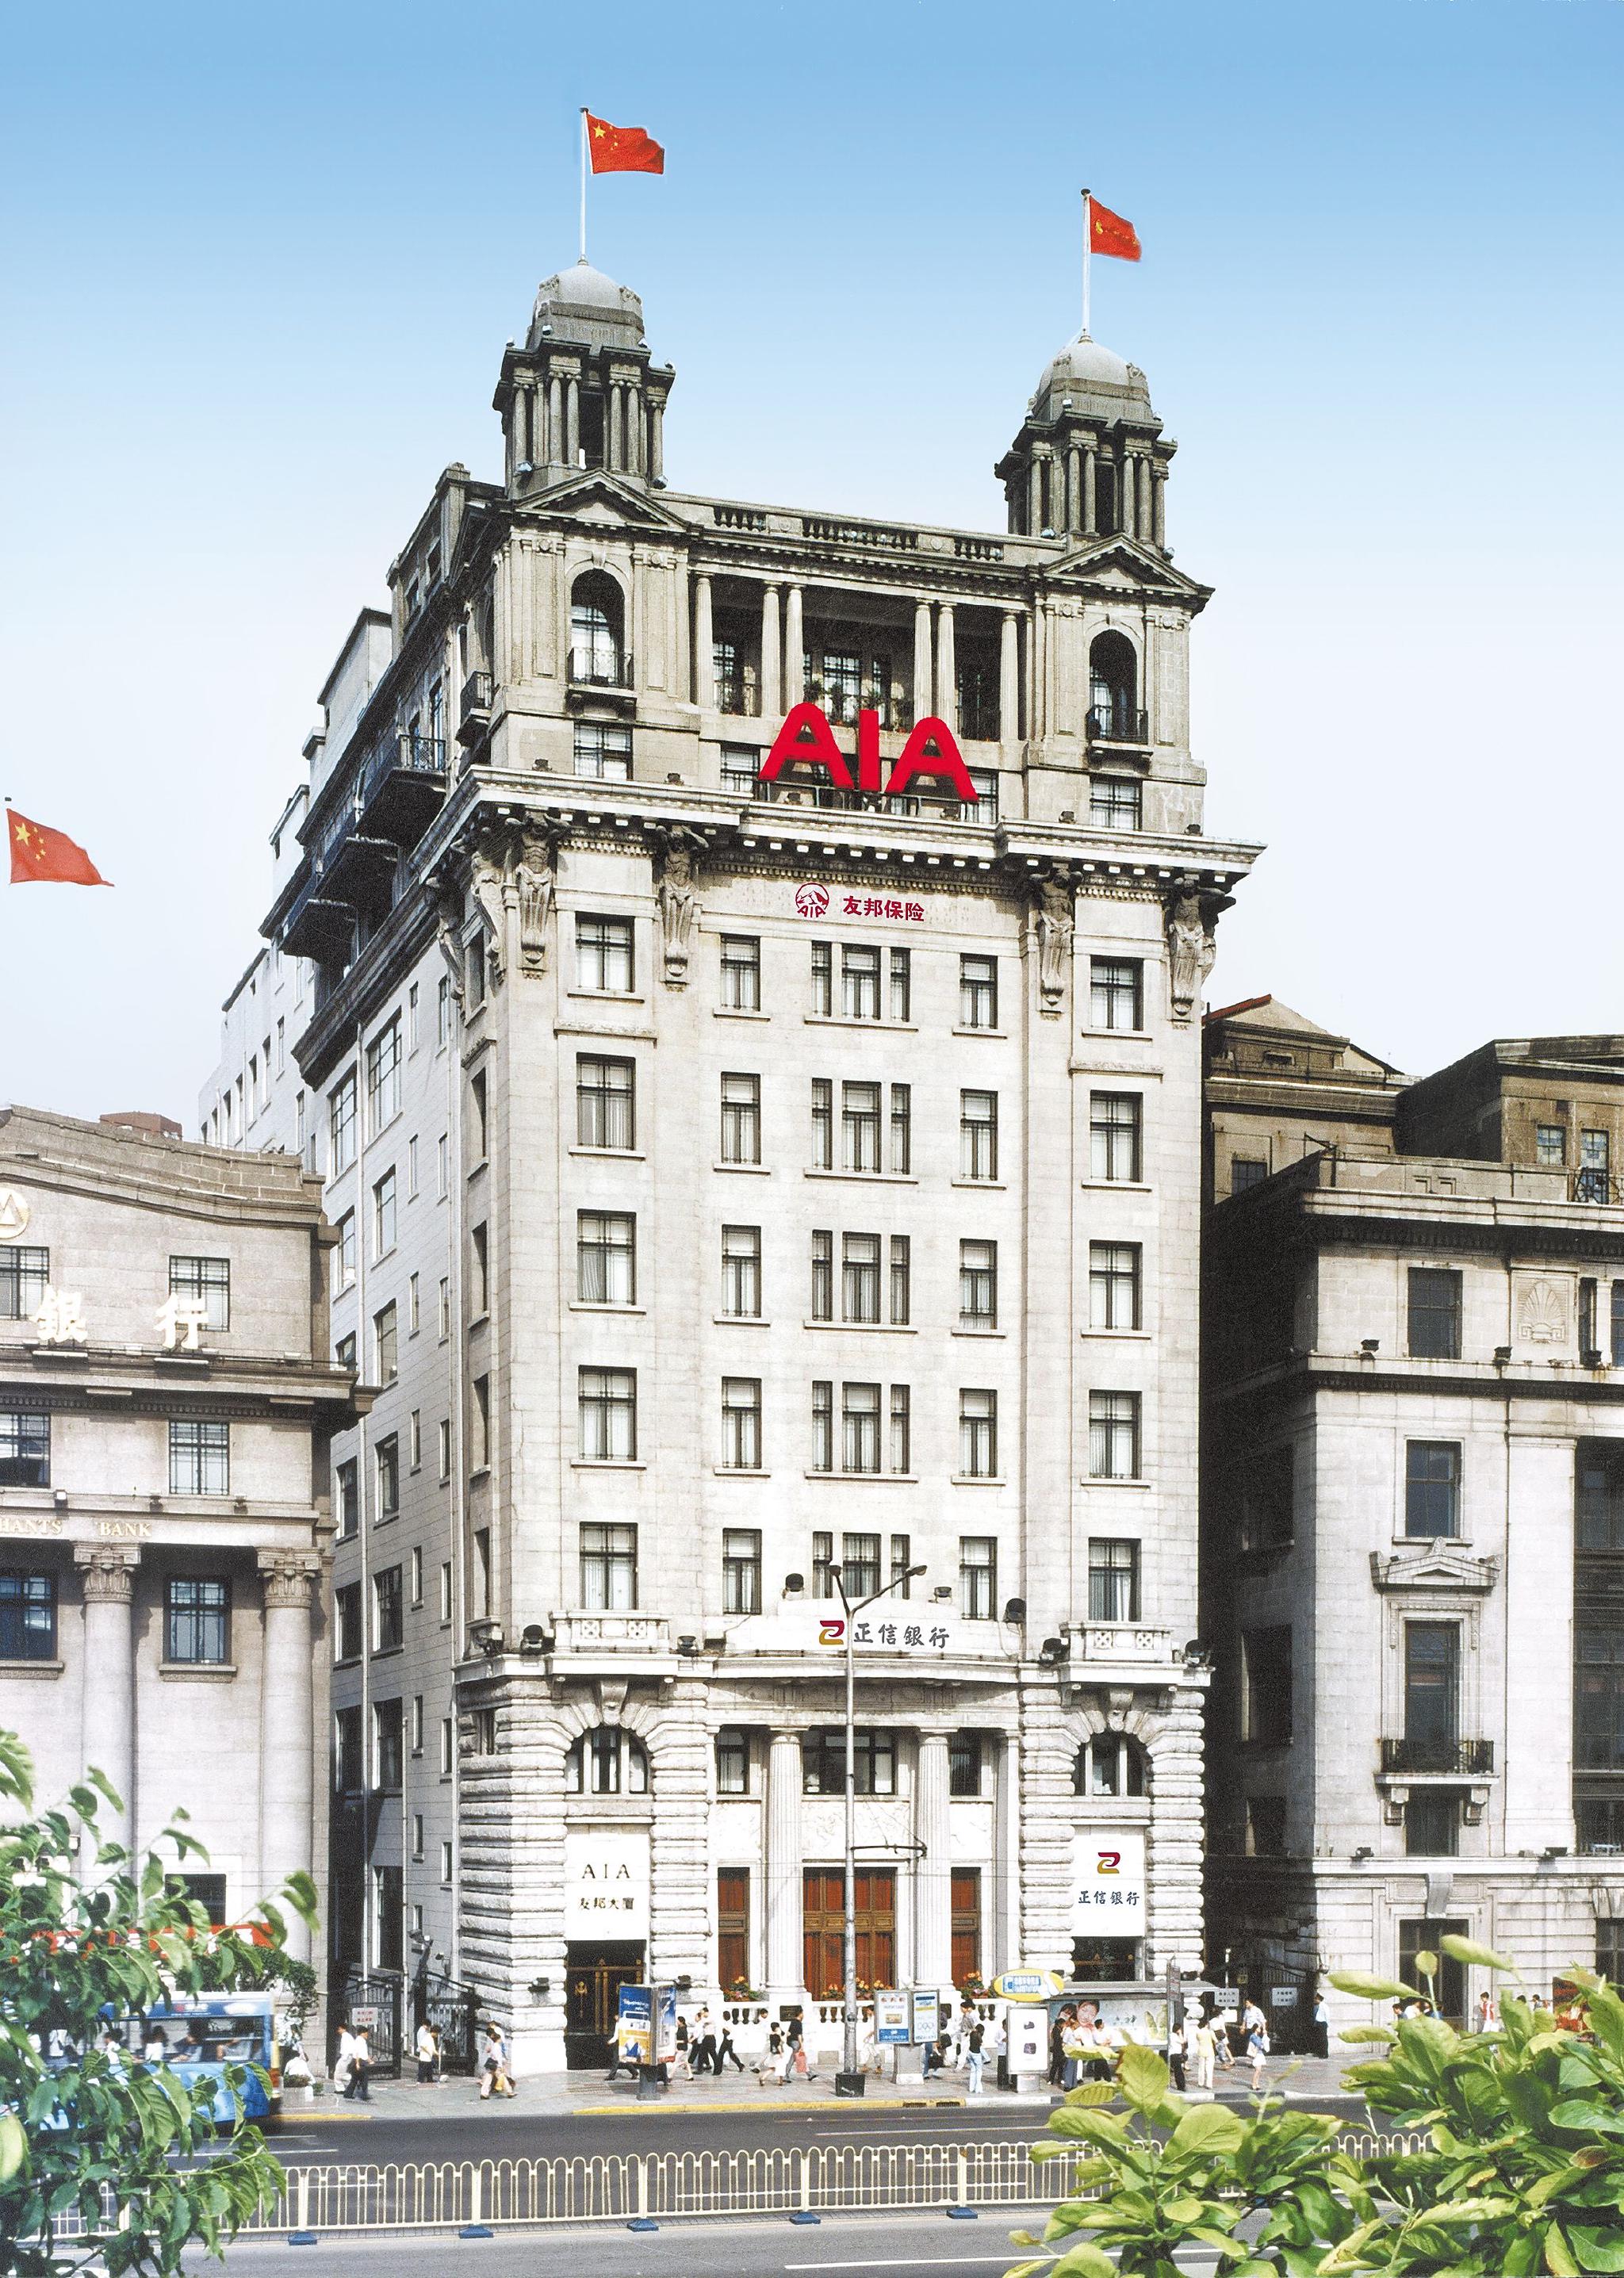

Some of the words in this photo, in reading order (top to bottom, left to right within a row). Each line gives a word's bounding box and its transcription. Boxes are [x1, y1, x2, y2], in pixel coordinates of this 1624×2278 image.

[758, 701, 980, 802] AIA
[797, 905, 826, 918] AIA
[842, 895, 925, 922] 友邦保险
[99, 1522, 152, 1537] BANK
[853, 1622, 950, 1649] 正信銀行
[581, 1863, 630, 1879] AIA
[1078, 1889, 1140, 1906] 正信銀行
